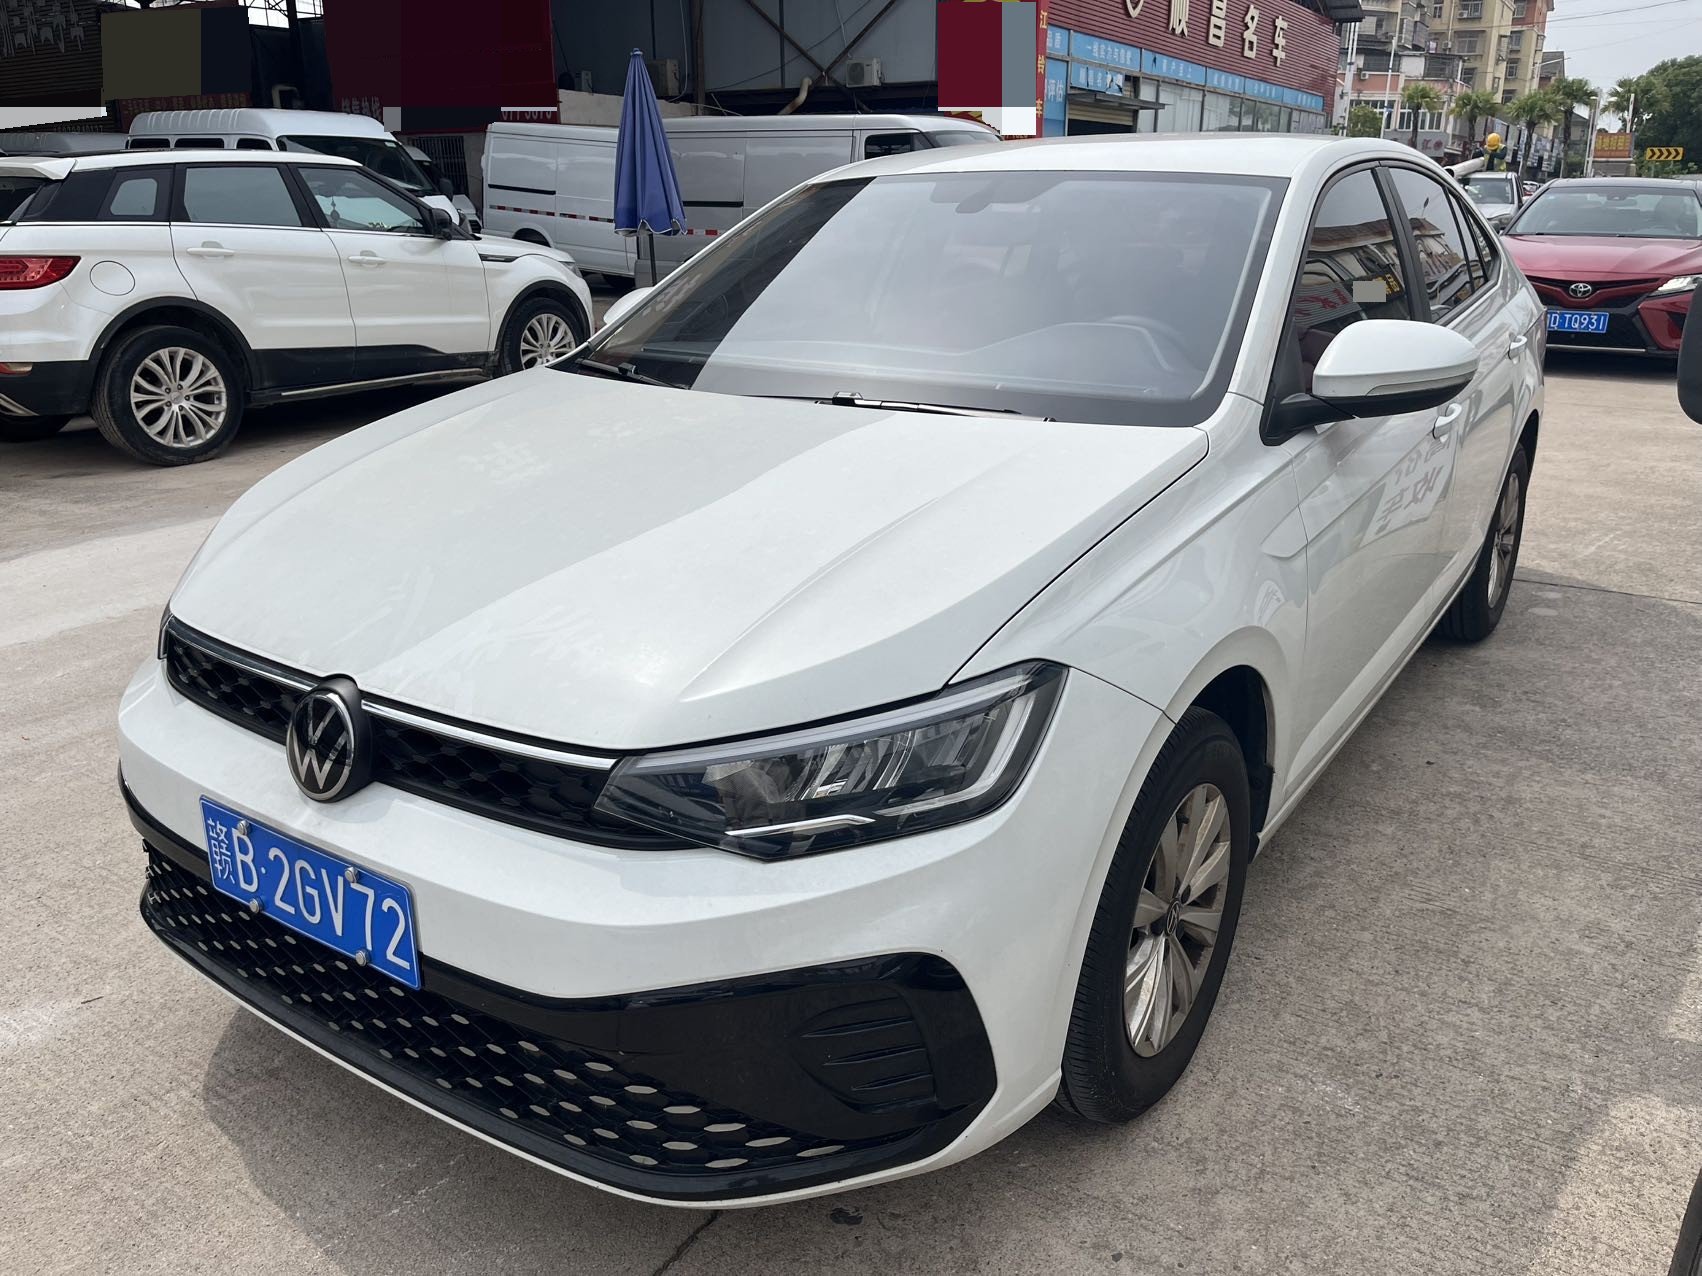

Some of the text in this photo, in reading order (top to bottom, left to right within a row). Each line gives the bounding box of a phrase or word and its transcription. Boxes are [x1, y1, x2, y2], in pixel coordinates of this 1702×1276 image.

[1168, 0, 1288, 67] 顺昌名车
[1547, 313, 1605, 330] D·TQ931
[206, 817, 411, 971] 赣B·2GV72
